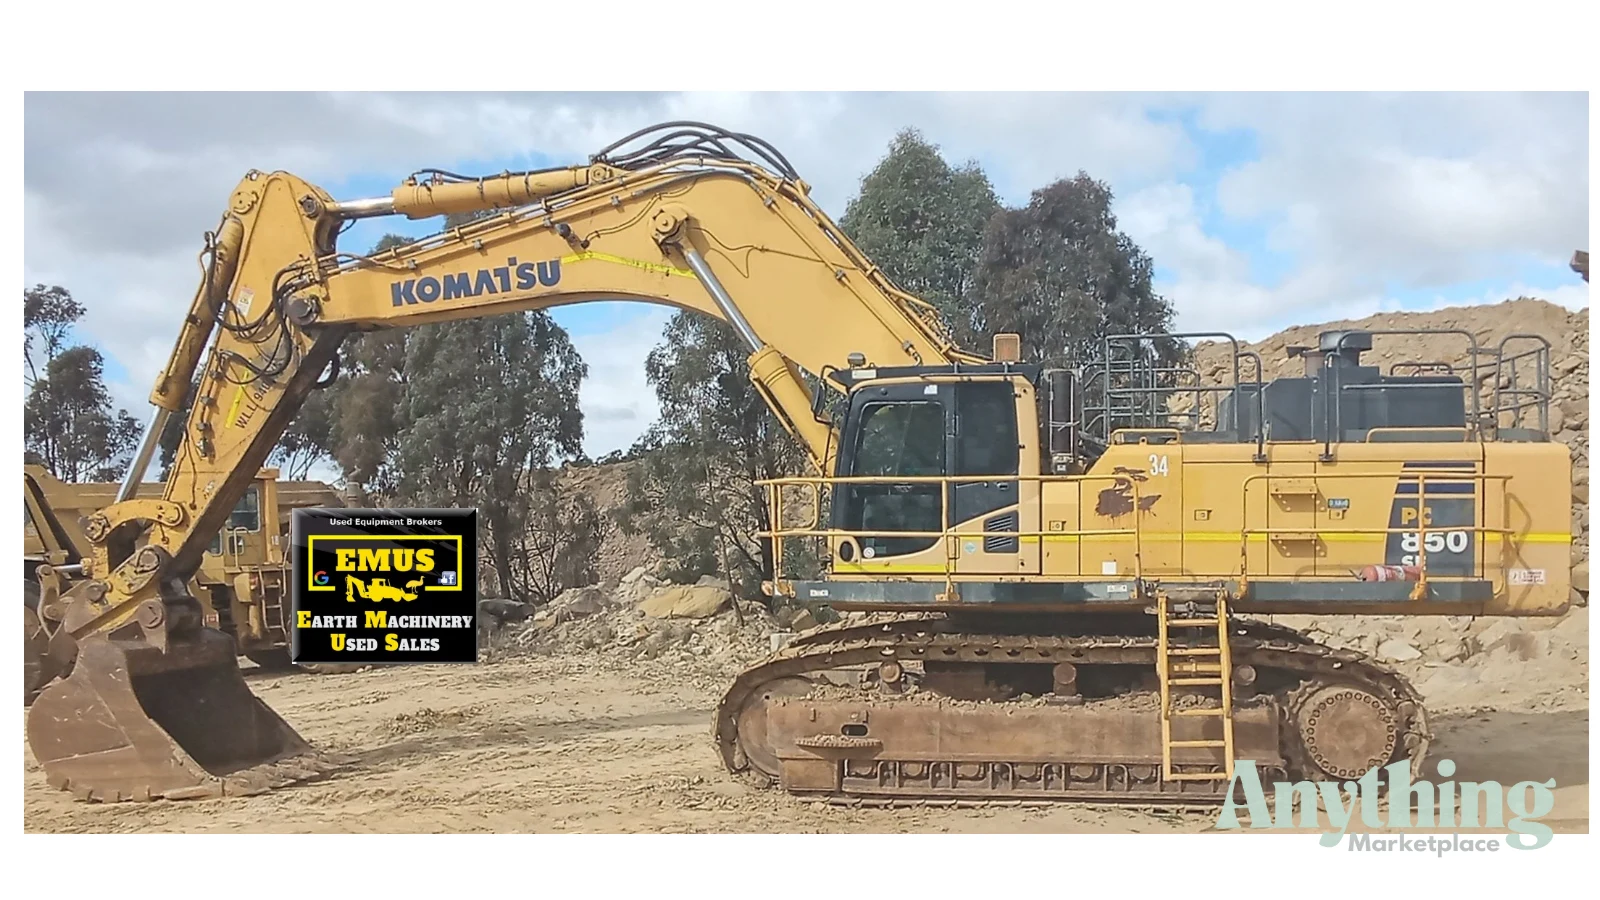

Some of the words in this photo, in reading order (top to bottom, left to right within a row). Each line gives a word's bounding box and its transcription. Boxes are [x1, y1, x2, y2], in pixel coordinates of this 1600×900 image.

[391, 257, 561, 306] KOMATSU
[1149, 454, 1168, 477] 34
[1401, 531, 1468, 553] 850
